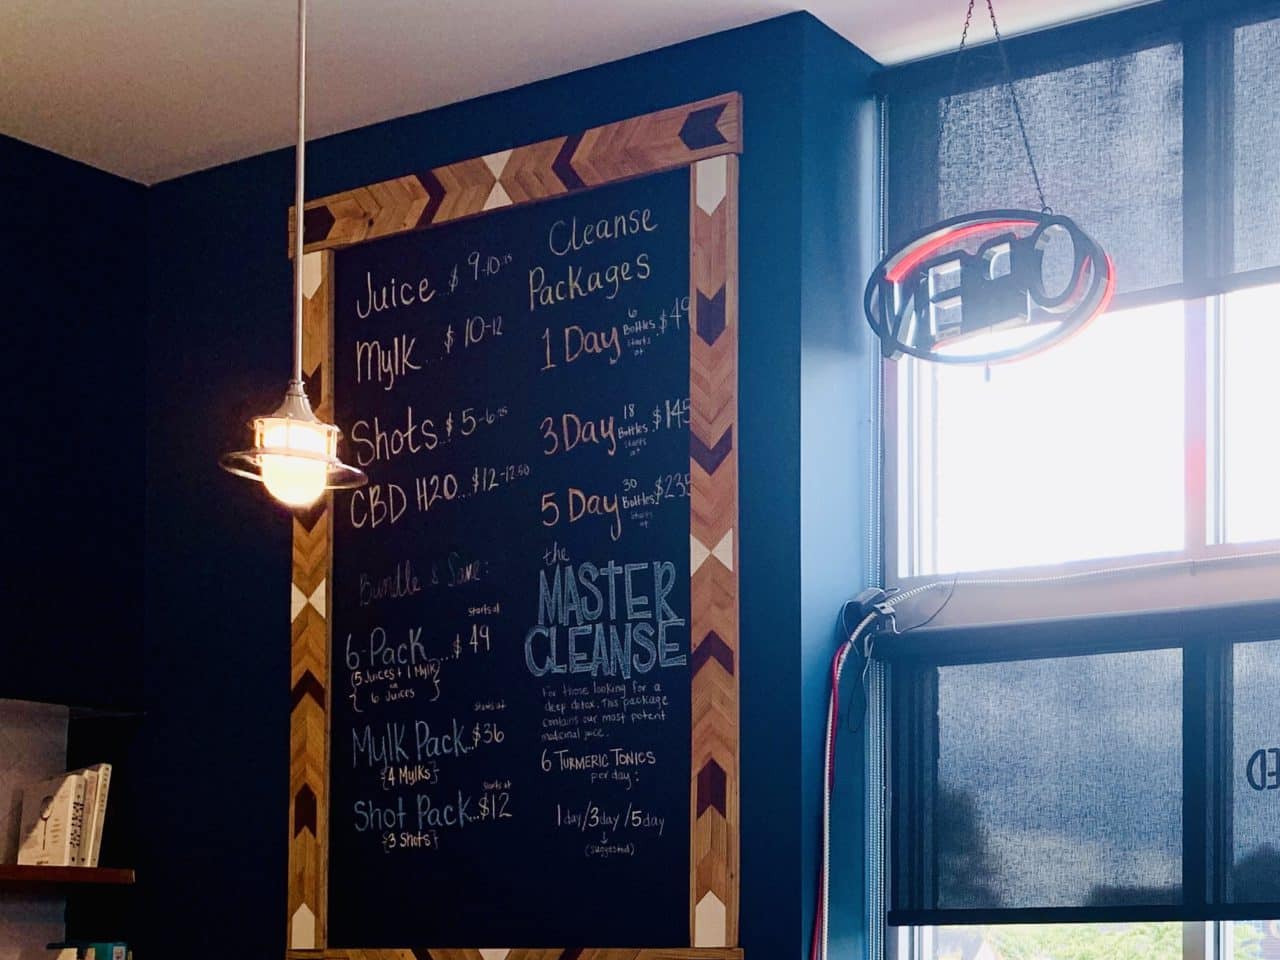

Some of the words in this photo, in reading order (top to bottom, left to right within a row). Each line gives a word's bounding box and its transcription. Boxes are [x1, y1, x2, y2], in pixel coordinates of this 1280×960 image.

[550, 208, 658, 255] Cleanse
[357, 272, 436, 318] Juice
[529, 254, 652, 311] Packages
[564, 326, 621, 365] Day
[623, 403, 636, 420] 18
[351, 406, 438, 466] Shots
[563, 414, 617, 456] Day
[350, 484, 407, 529] CBD
[622, 478, 638, 492] 30
[541, 493, 560, 527] 5
[568, 488, 622, 541] Day
[543, 541, 570, 566] the
[360, 559, 422, 607] Bundle
[538, 560, 680, 627] MASTER
[524, 618, 688, 680] CLEANSE
[593, 680, 626, 700] looking
[415, 717, 467, 762] Pack
[631, 711, 667, 723] potent
[541, 748, 552, 772] 6
[610, 748, 657, 767] TONICS
[353, 796, 407, 832] Shot
[416, 789, 472, 831] Pack
